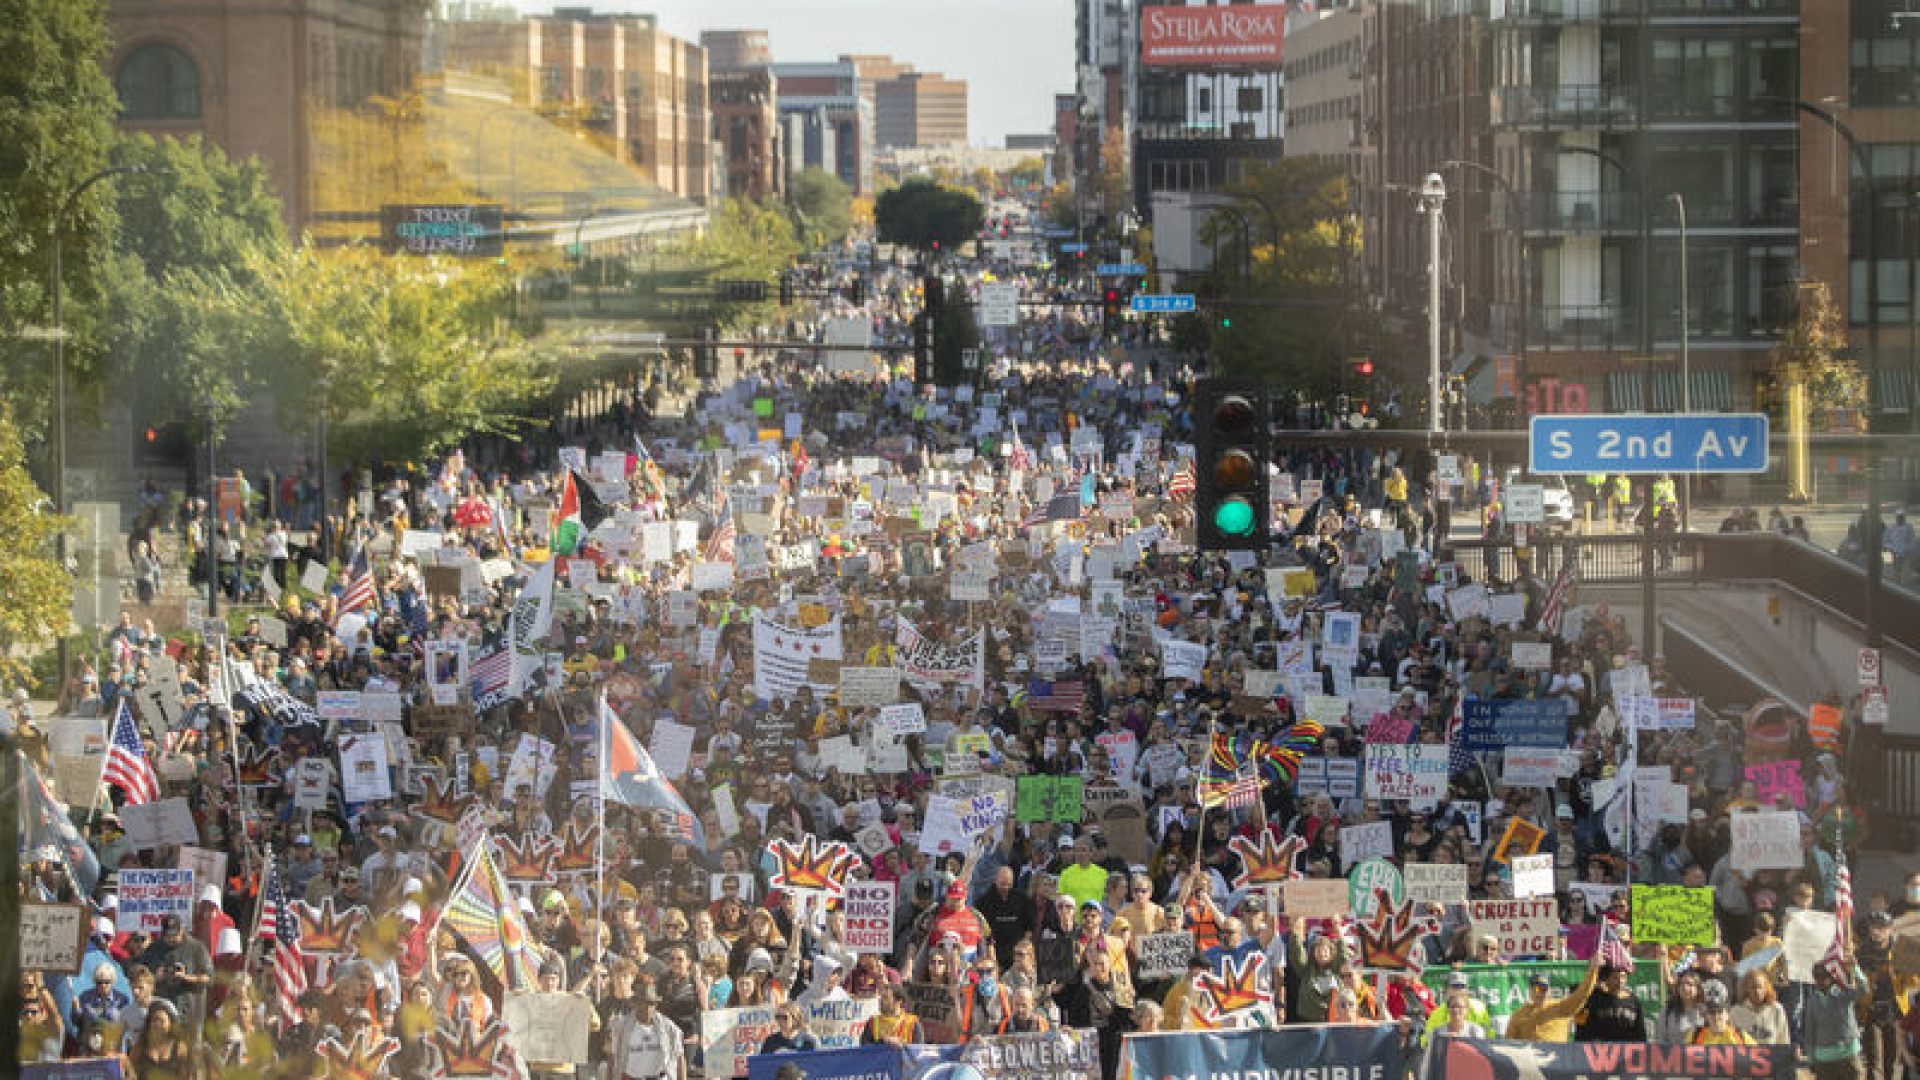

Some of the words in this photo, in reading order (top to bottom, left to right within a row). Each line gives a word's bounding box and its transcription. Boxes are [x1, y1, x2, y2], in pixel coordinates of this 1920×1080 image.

[1151, 11, 1218, 41] STELLA
[1221, 11, 1275, 40] ROSA
[1549, 431, 1573, 460] S
[1596, 429, 1672, 459] 2nd
[1696, 430, 1749, 459] Av
[1473, 705, 1491, 715] IN
[1368, 758, 1402, 771] FREE
[847, 887, 889, 901] NO
[846, 902, 889, 916] KINGS
[1474, 901, 1551, 920] CRUELTY
[847, 919, 889, 931] NO
[1519, 921, 1530, 931] A
[846, 932, 889, 947] FASCISTS
[811, 1000, 863, 1021] WHICH
[1583, 1043, 1773, 1076] WOMEN'S
